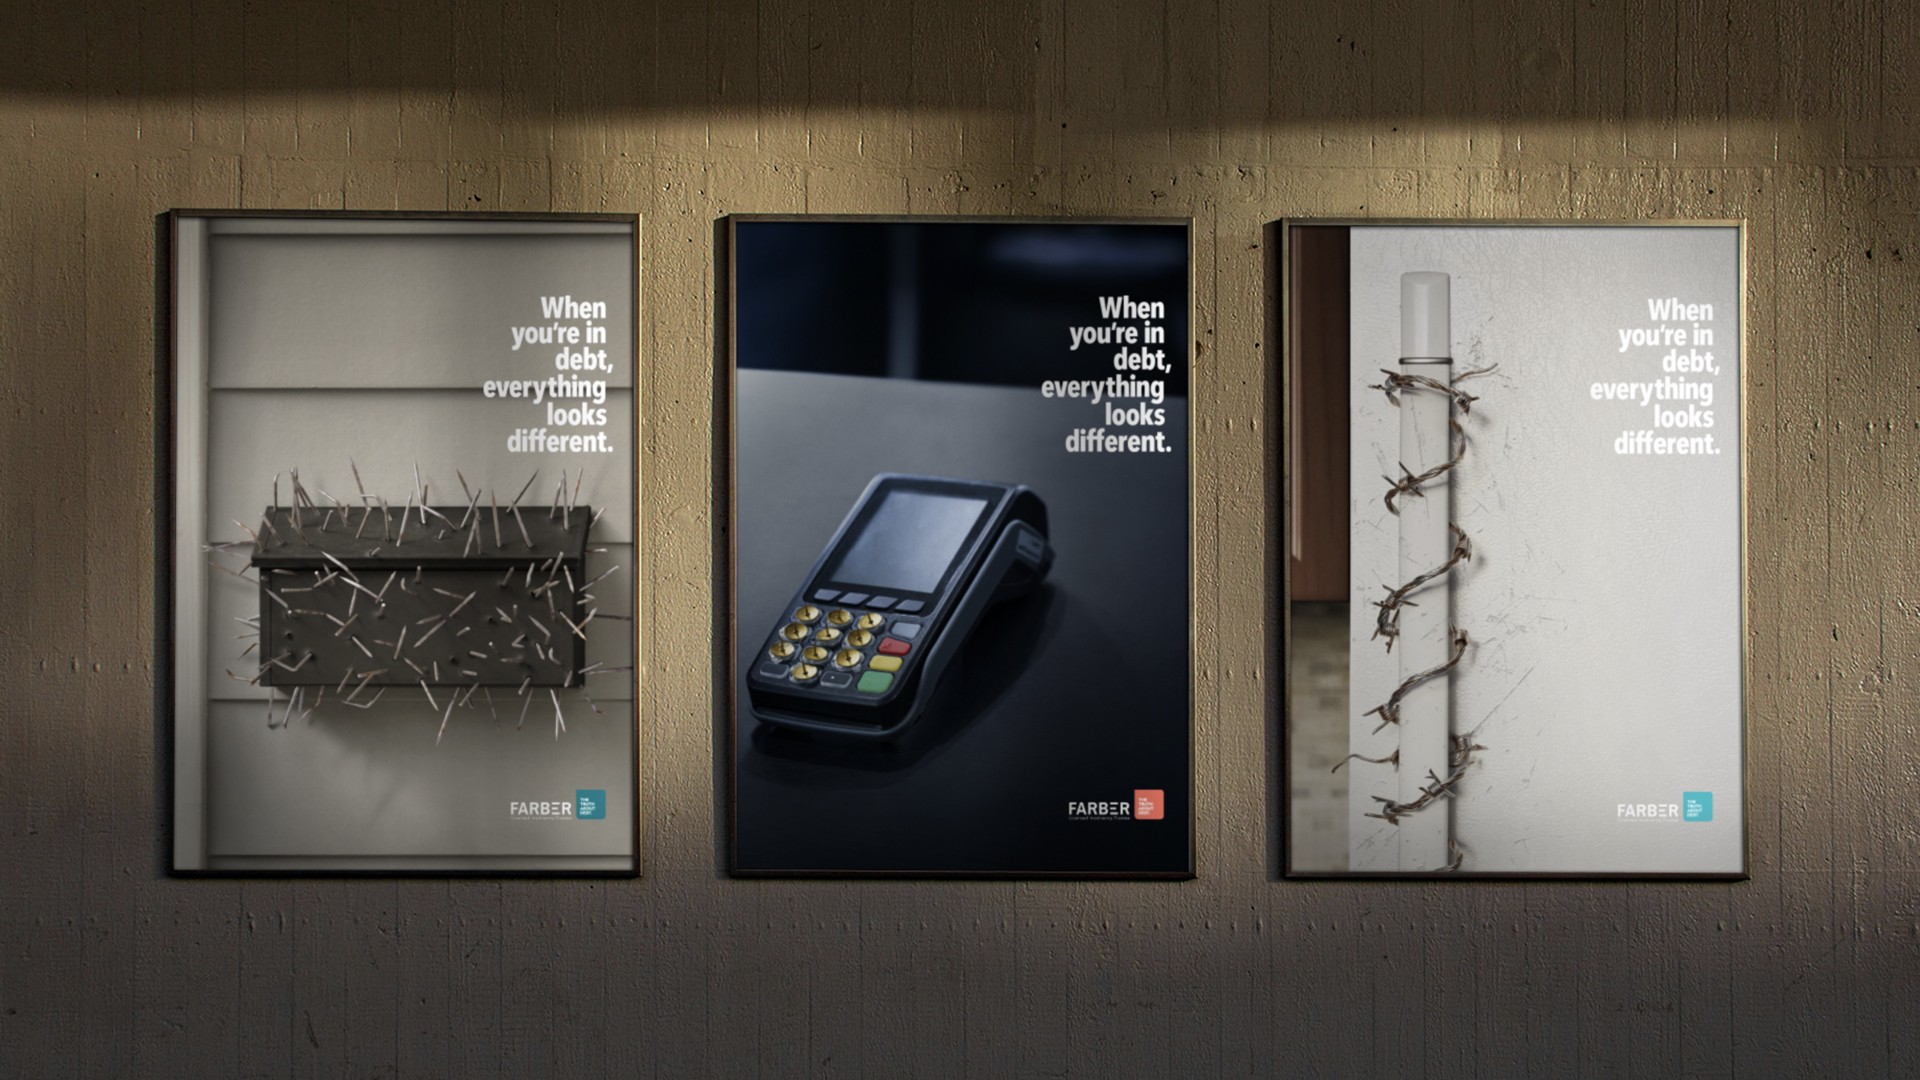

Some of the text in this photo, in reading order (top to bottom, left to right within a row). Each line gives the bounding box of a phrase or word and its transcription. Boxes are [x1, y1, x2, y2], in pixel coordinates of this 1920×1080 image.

[541, 295, 606, 319] When
[1099, 295, 1165, 319] When
[1648, 297, 1713, 321] When
[511, 320, 606, 350] you're in
[1069, 320, 1165, 350] you're in
[1618, 322, 1713, 353] you're in
[555, 346, 613, 374] debt,
[1113, 346, 1172, 374] debt,
[1662, 348, 1720, 376] debt,
[483, 373, 606, 404] everything
[1041, 373, 1165, 404] everything
[1590, 376, 1713, 406] everything
[547, 402, 607, 426] looks
[1105, 402, 1165, 426] looks
[1654, 404, 1714, 428] looks
[507, 428, 613, 452] different.
[1065, 428, 1172, 452] different.
[1614, 430, 1721, 454] different.
[510, 801, 572, 815] FARBER
[1068, 801, 1130, 815] FARBER
[1617, 804, 1679, 817] FARBER
